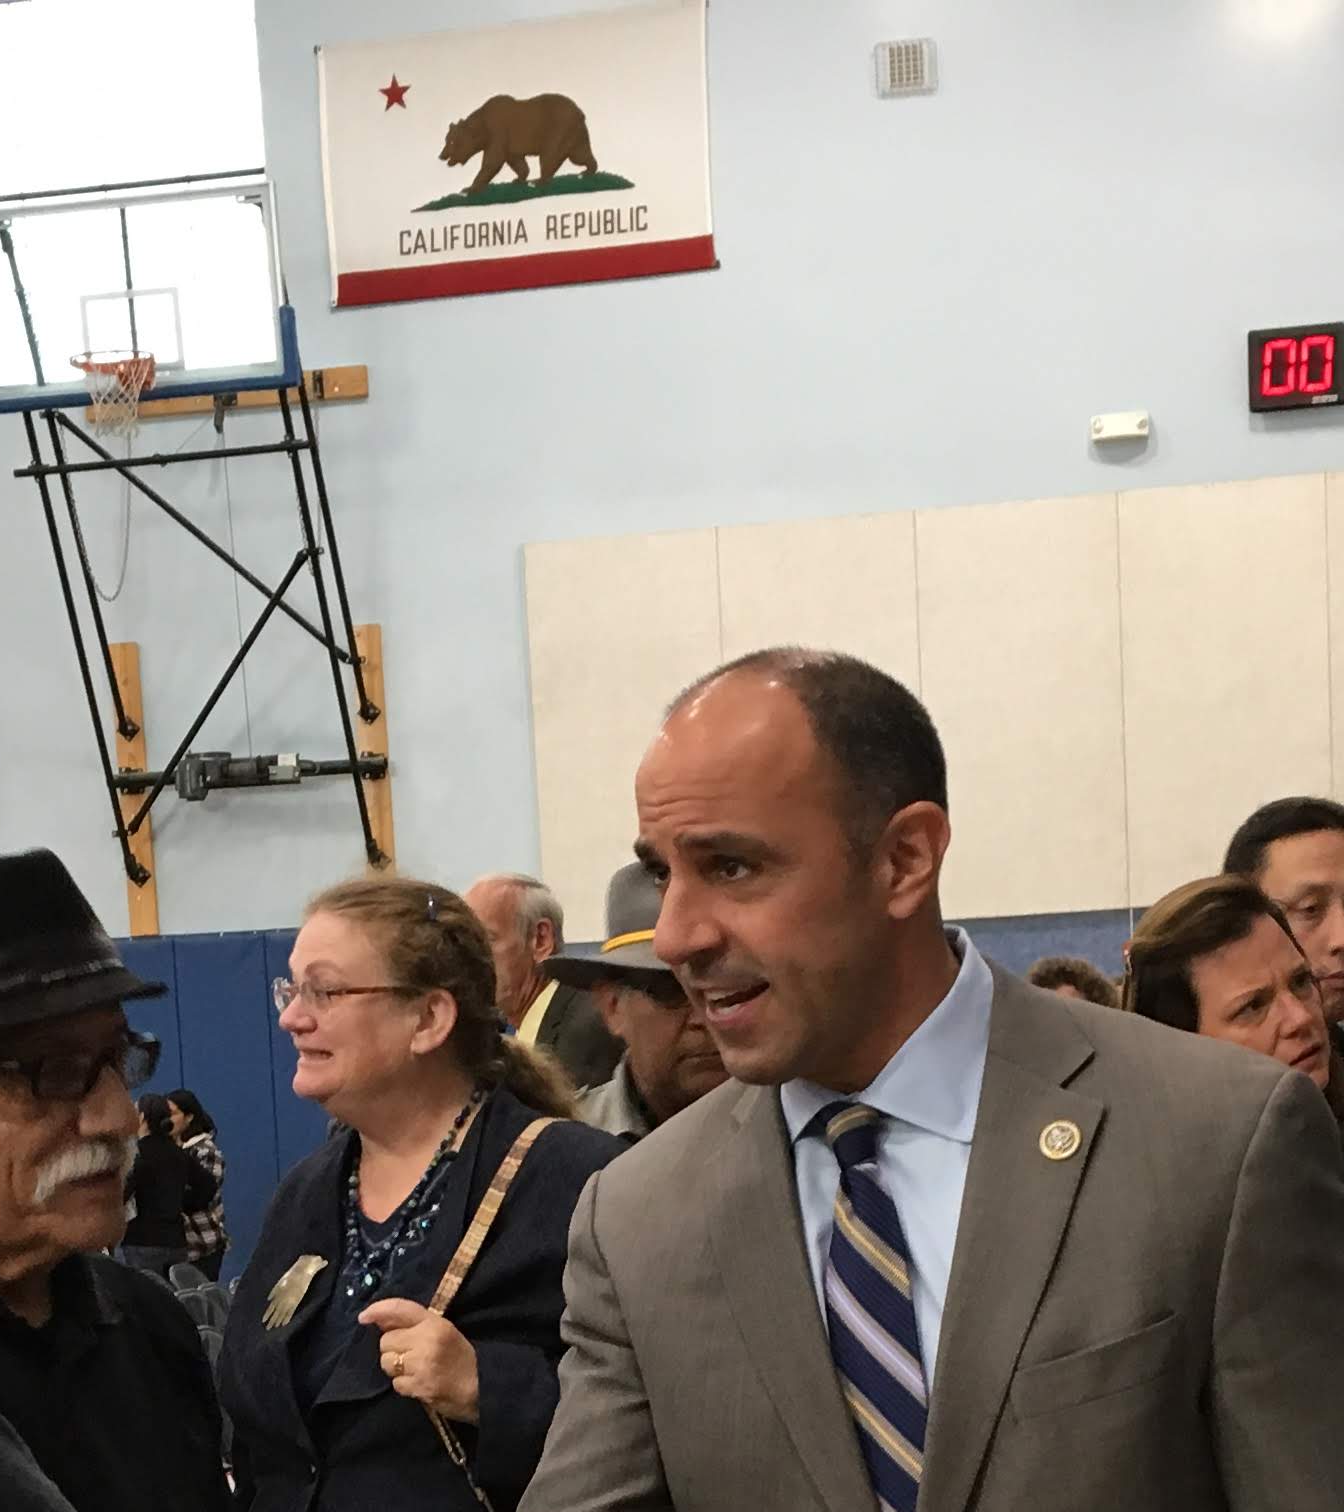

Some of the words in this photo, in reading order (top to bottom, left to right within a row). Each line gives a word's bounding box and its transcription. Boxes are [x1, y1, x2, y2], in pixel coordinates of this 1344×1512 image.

[399, 218, 528, 256] CALIFORNIA
[545, 205, 648, 240] REPUBLIC
[1261, 334, 1335, 397] 00
